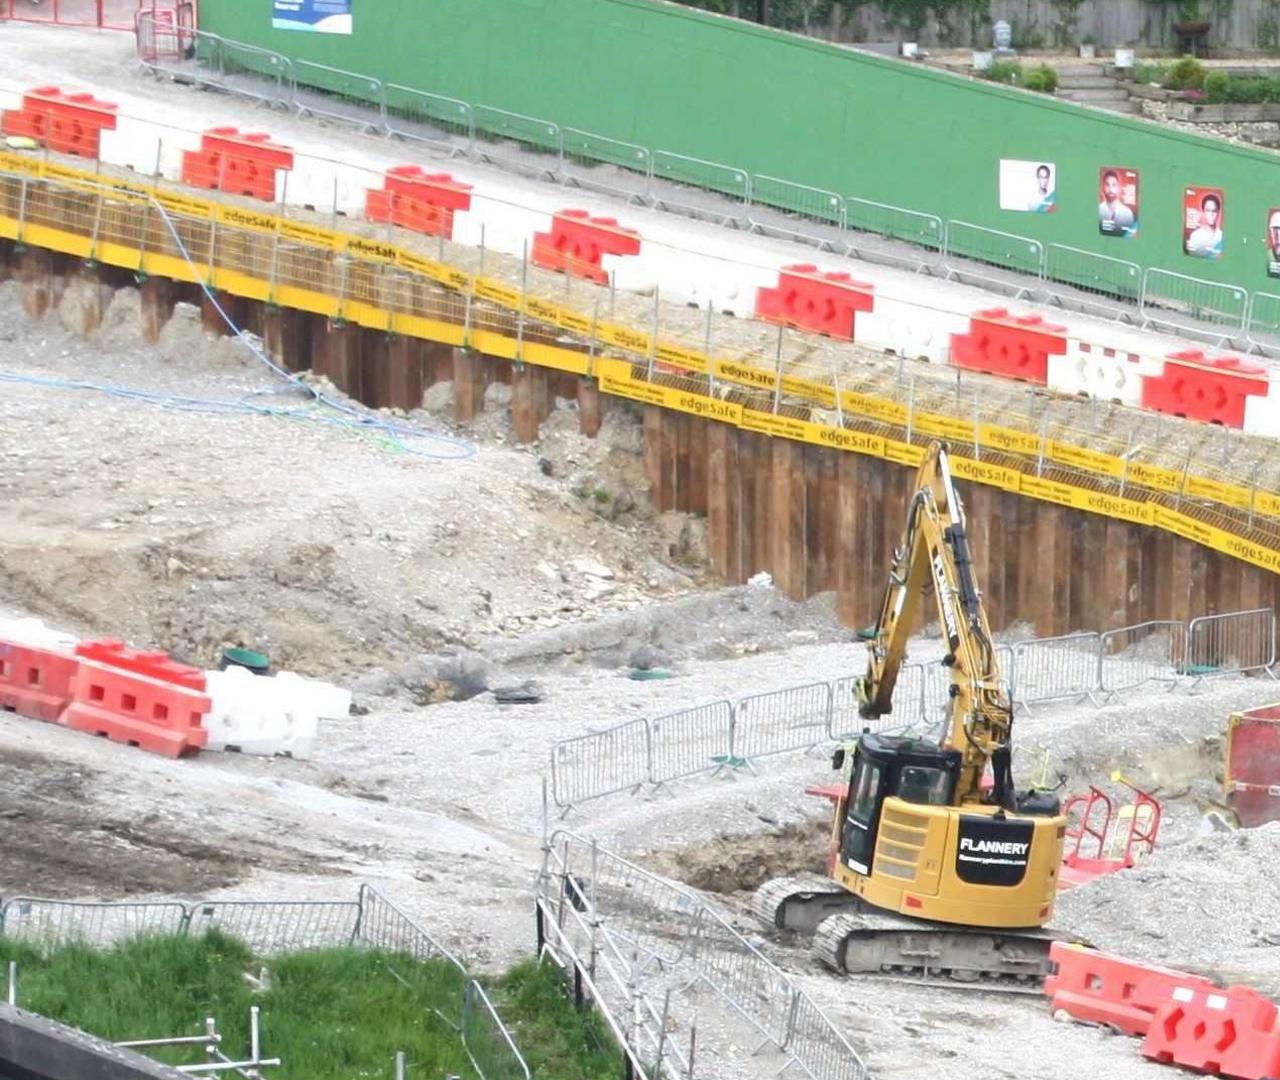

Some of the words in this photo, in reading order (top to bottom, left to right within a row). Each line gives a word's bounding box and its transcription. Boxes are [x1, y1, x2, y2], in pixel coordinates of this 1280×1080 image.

[720, 364, 776, 387] edgeSafe
[680, 397, 737, 419] edgeSafe
[820, 429, 880, 451] edgeSafe
[956, 461, 1015, 484] edgeSafe
[1088, 494, 1150, 520] edgeSafe
[960, 837, 1028, 854] FLANNERY
